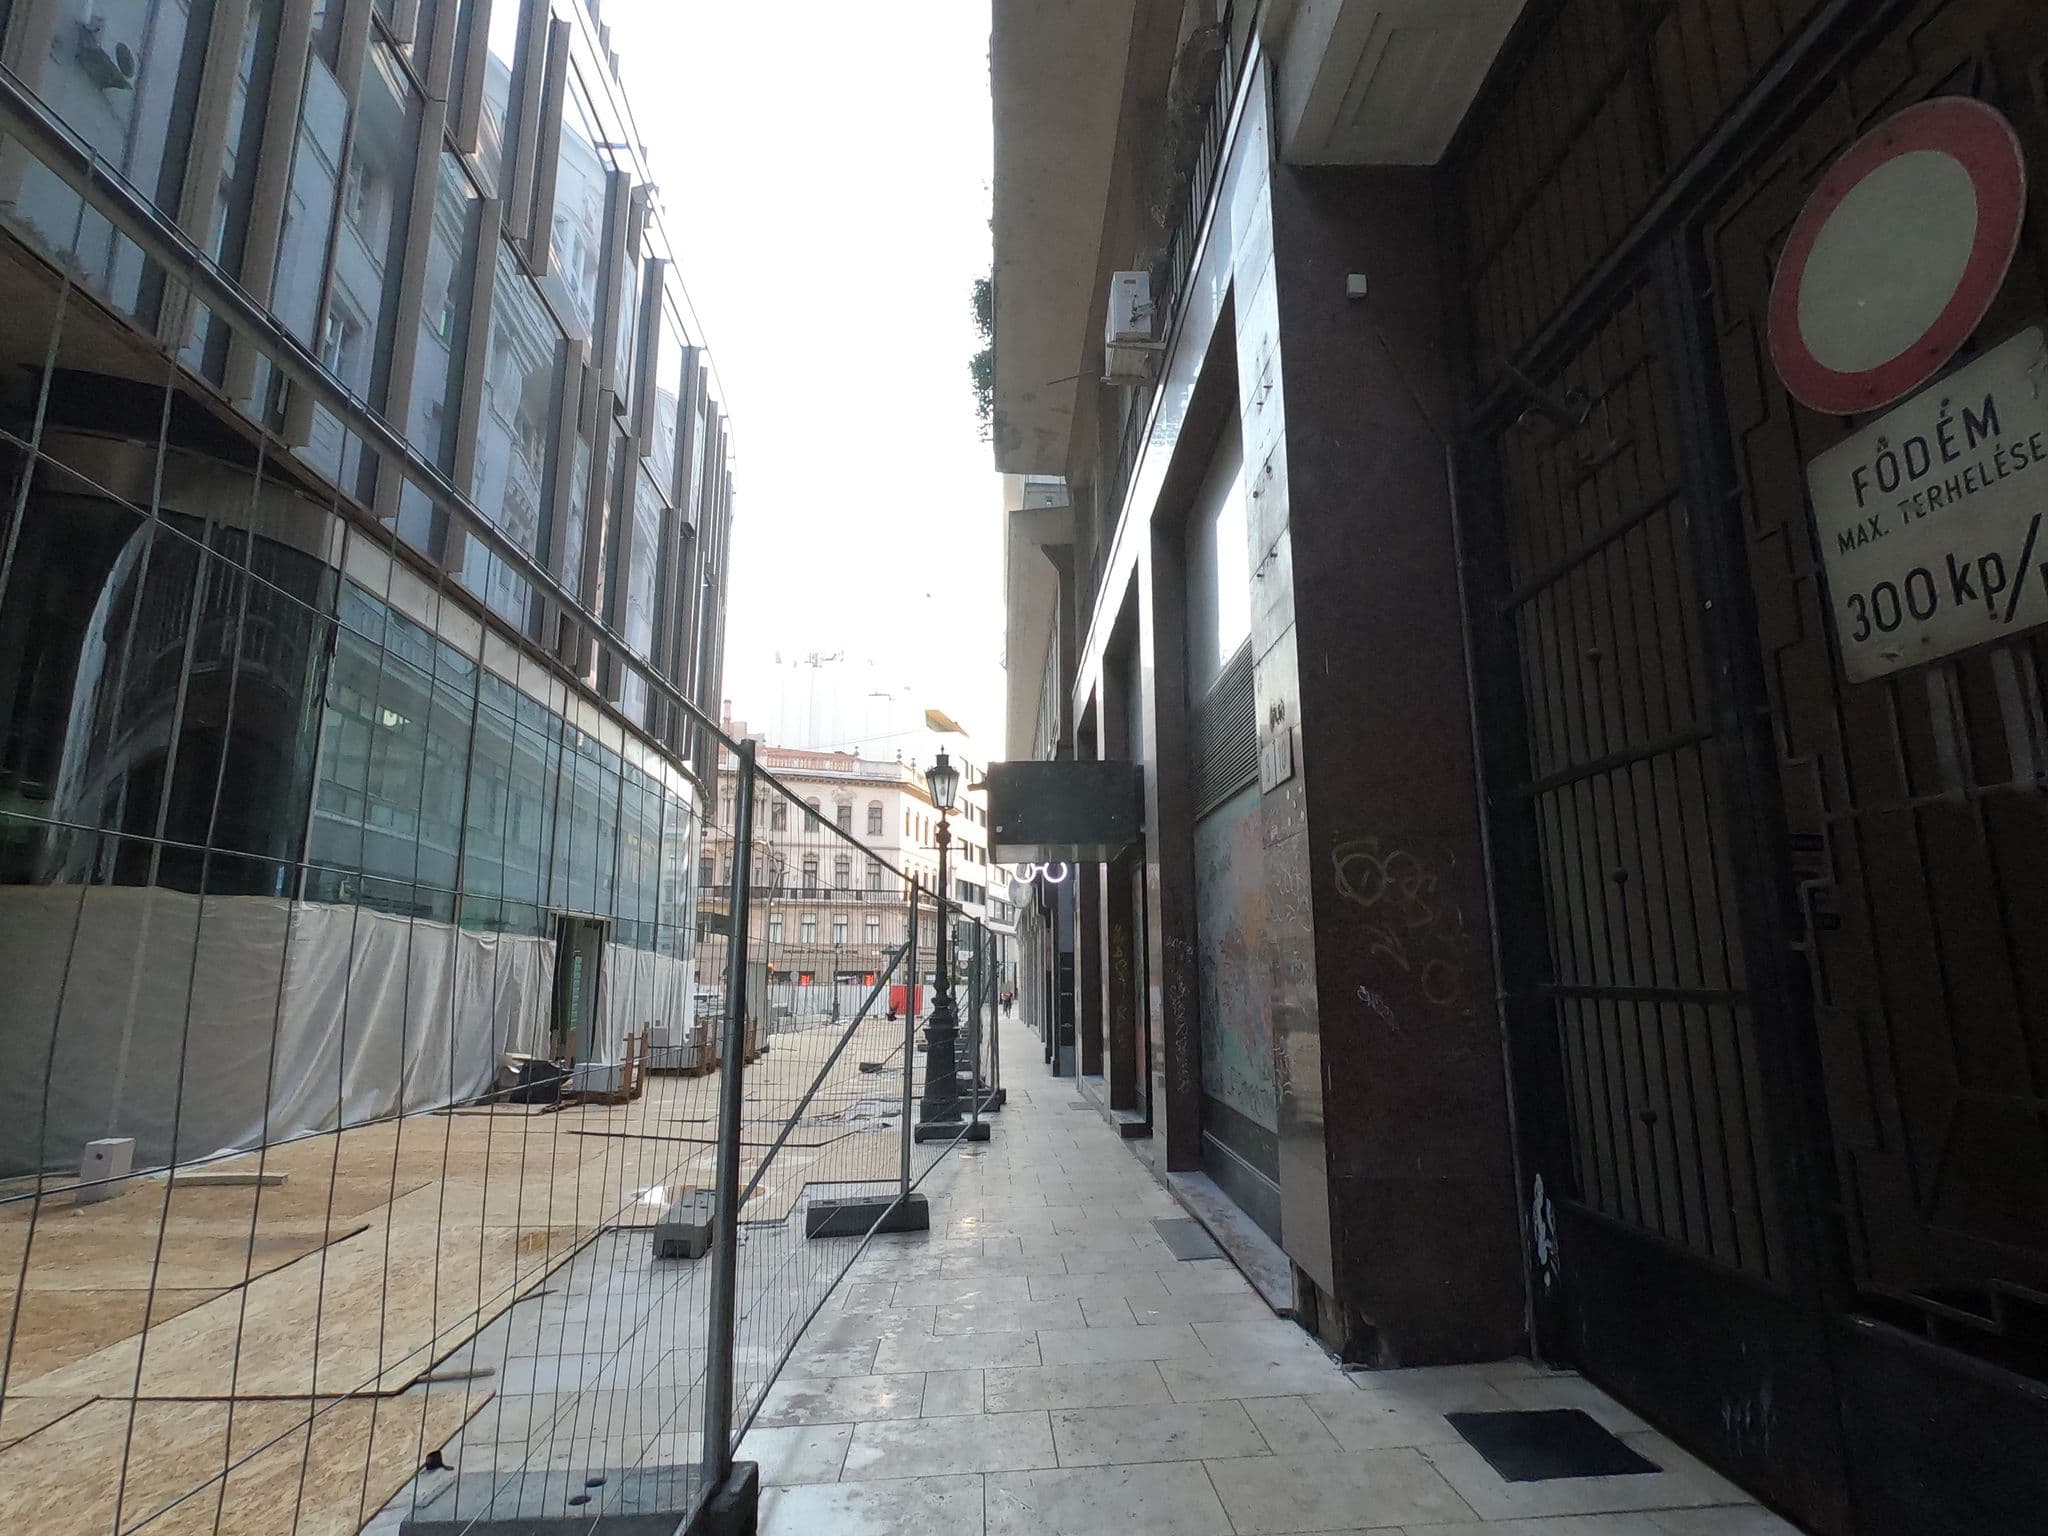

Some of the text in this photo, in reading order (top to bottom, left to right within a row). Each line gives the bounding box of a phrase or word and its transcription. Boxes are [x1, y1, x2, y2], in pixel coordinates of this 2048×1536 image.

[1837, 432, 2048, 555] MAX. TERHELÉSE
[1847, 512, 2048, 642] 300 kp/
